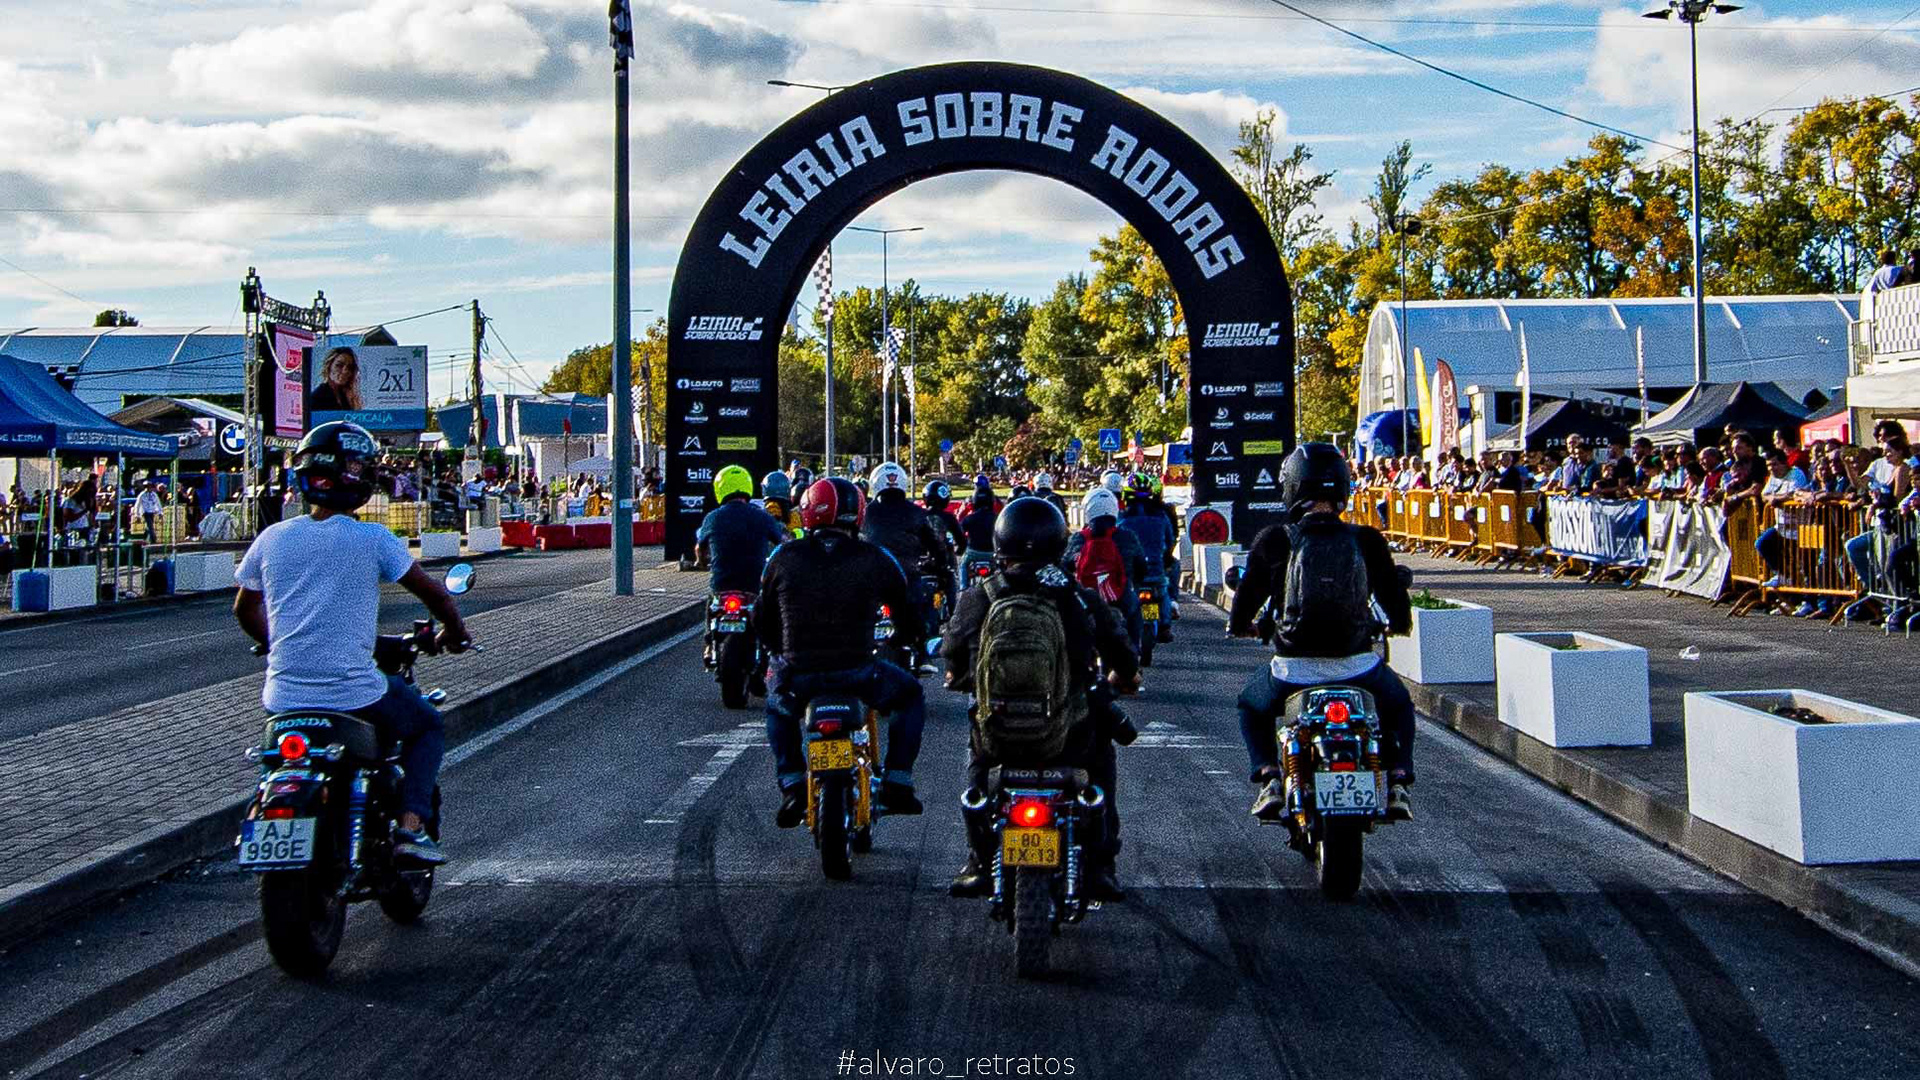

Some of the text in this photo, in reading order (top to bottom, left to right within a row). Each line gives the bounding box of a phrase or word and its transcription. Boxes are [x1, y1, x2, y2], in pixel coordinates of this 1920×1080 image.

[719, 92, 1246, 280] LEIRIA SOBRE RODAS
[687, 316, 743, 331] LEIRIA
[1205, 323, 1259, 338] LEIRIA
[716, 331, 748, 340] RODAS
[1233, 337, 1264, 346] RODAS
[378, 368, 415, 392] 2x1
[274, 717, 332, 731] HONDA
[1335, 774, 1357, 790] 32
[263, 821, 296, 841] AJ
[247, 839, 305, 861] 99GE
